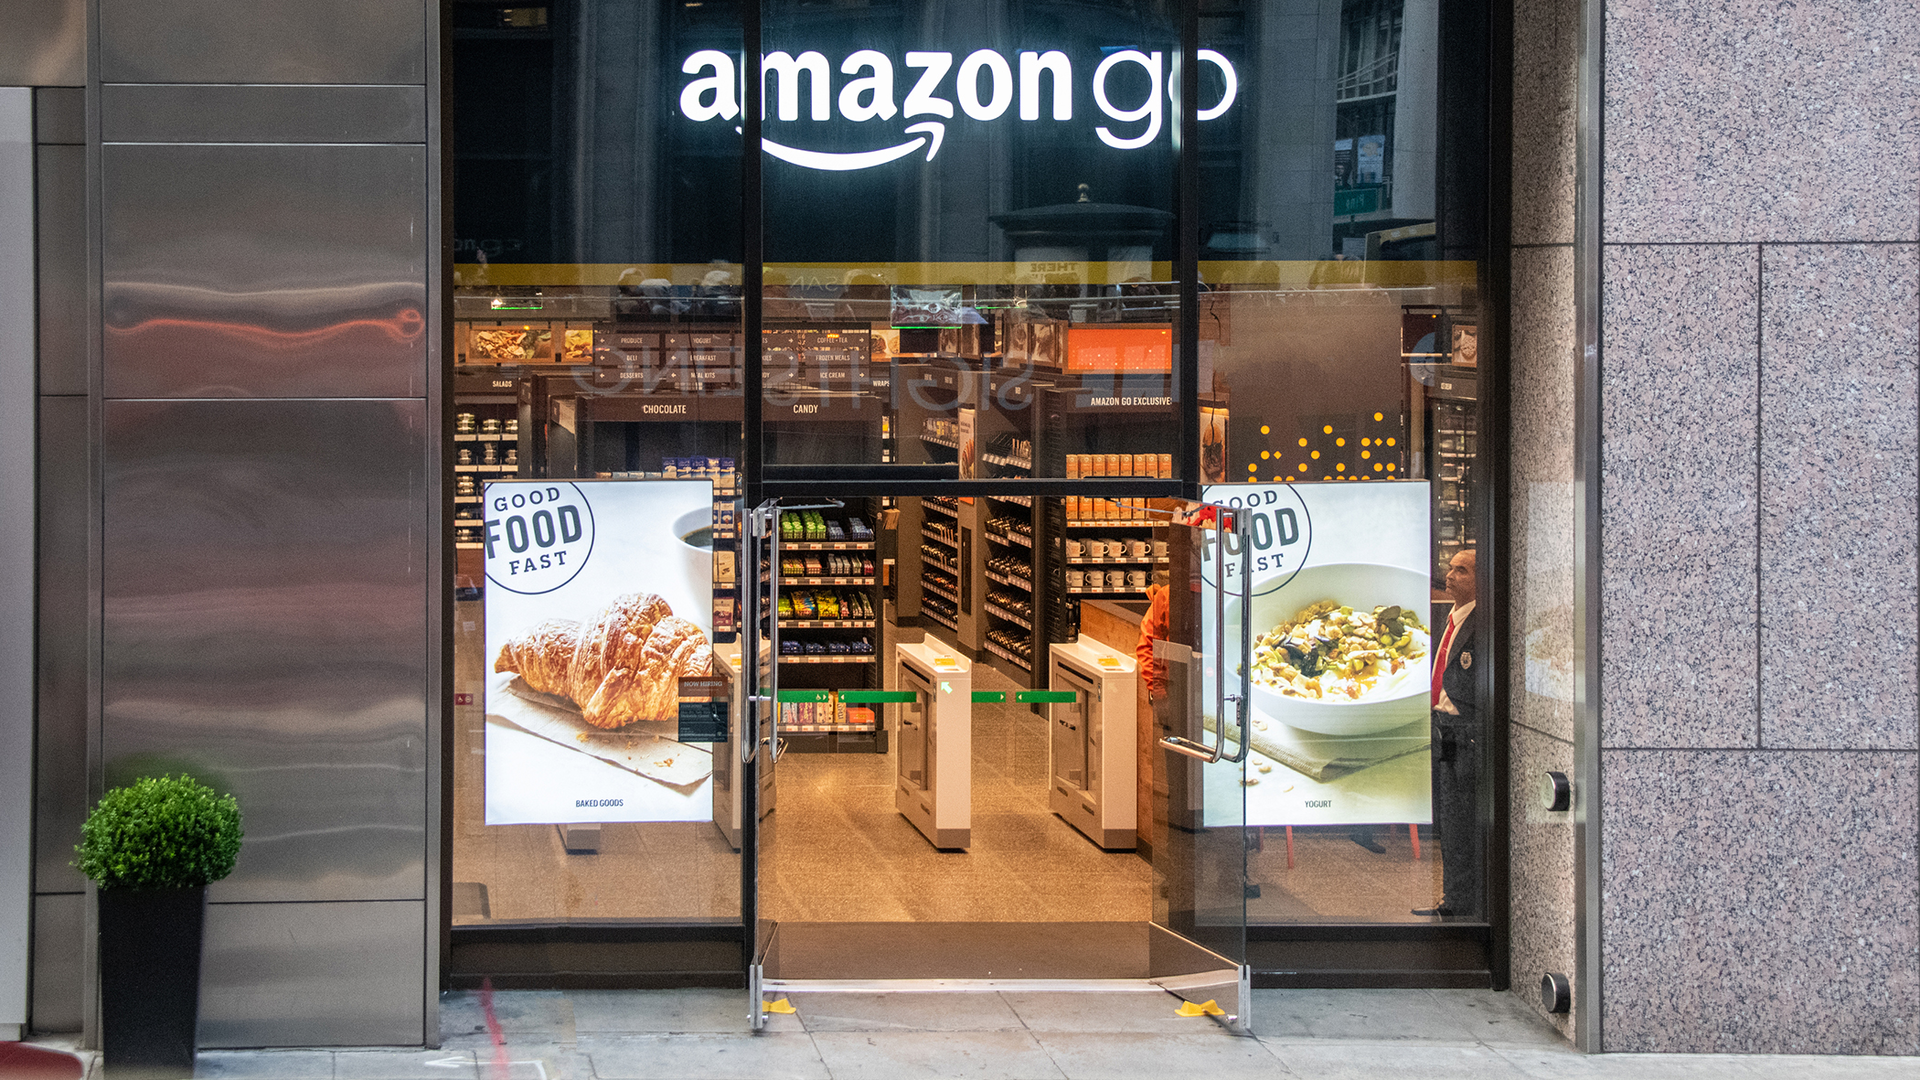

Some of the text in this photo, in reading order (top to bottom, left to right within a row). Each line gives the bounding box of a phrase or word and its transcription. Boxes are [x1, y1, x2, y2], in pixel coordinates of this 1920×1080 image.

[680, 49, 1238, 149] amazon go
[815, 353, 834, 361] FROZEN
[492, 380, 513, 388] SALADS
[1090, 397, 1120, 406] AMAZON
[1121, 397, 1132, 406] GO
[643, 404, 687, 414] CHOCOLATE
[793, 404, 819, 414] CANDY
[494, 487, 561, 511] GOOD
[485, 505, 583, 560] FOOD
[509, 550, 567, 575] FAST
[1225, 553, 1284, 577] FST
[575, 798, 624, 808] BAKED GOODS
[1304, 799, 1332, 808] YOGURT
